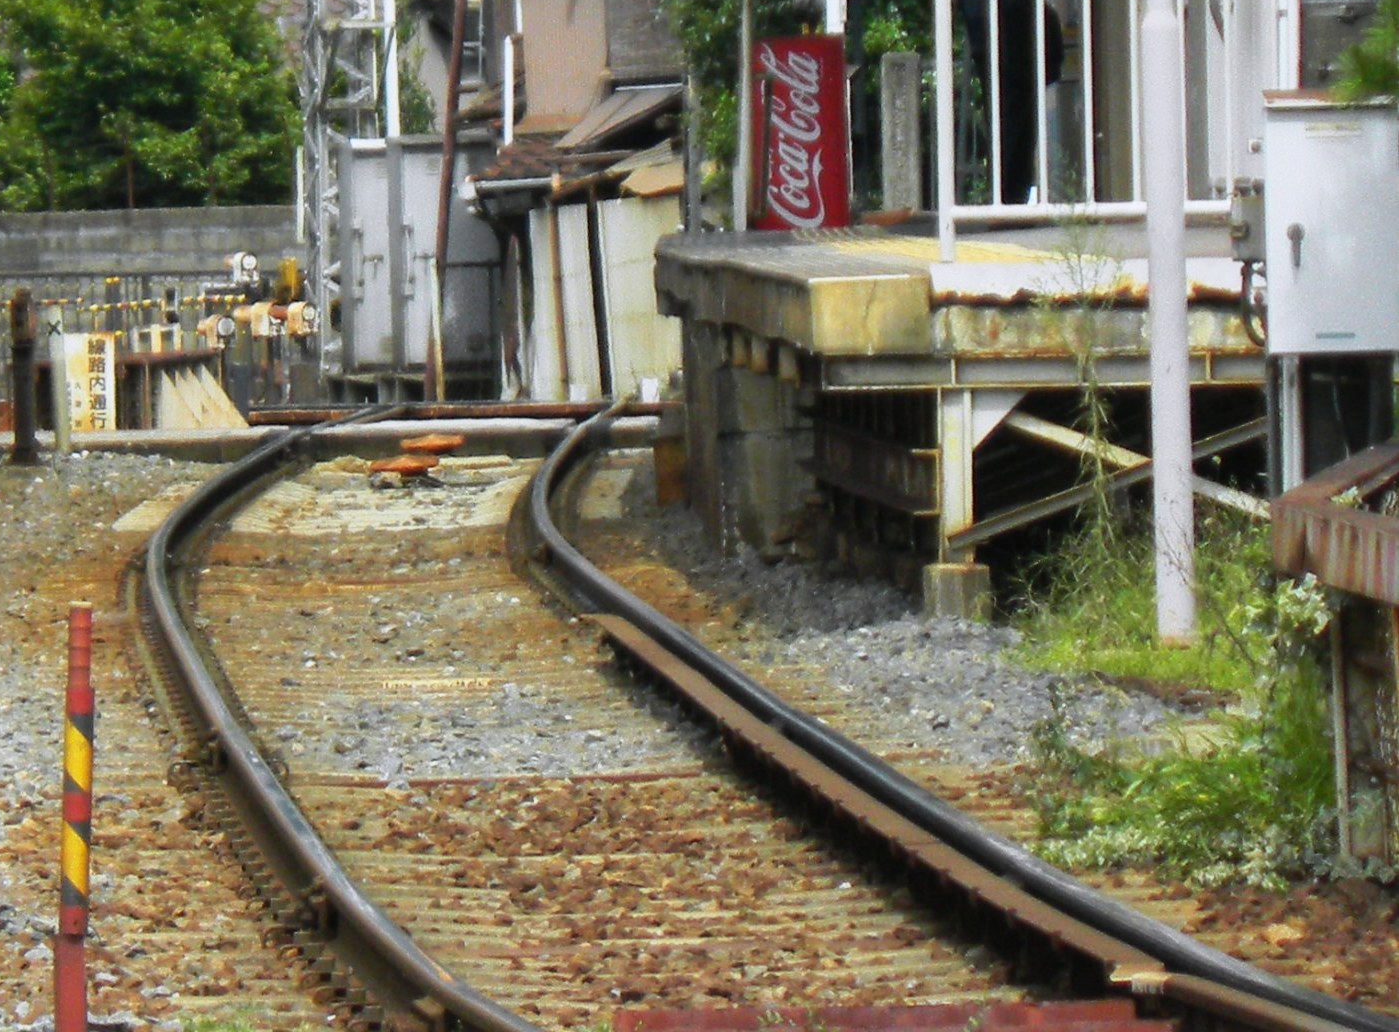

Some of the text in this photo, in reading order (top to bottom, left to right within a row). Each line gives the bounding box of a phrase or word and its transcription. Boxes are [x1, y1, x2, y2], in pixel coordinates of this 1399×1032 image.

[87, 338, 108, 429] 線路内通行
